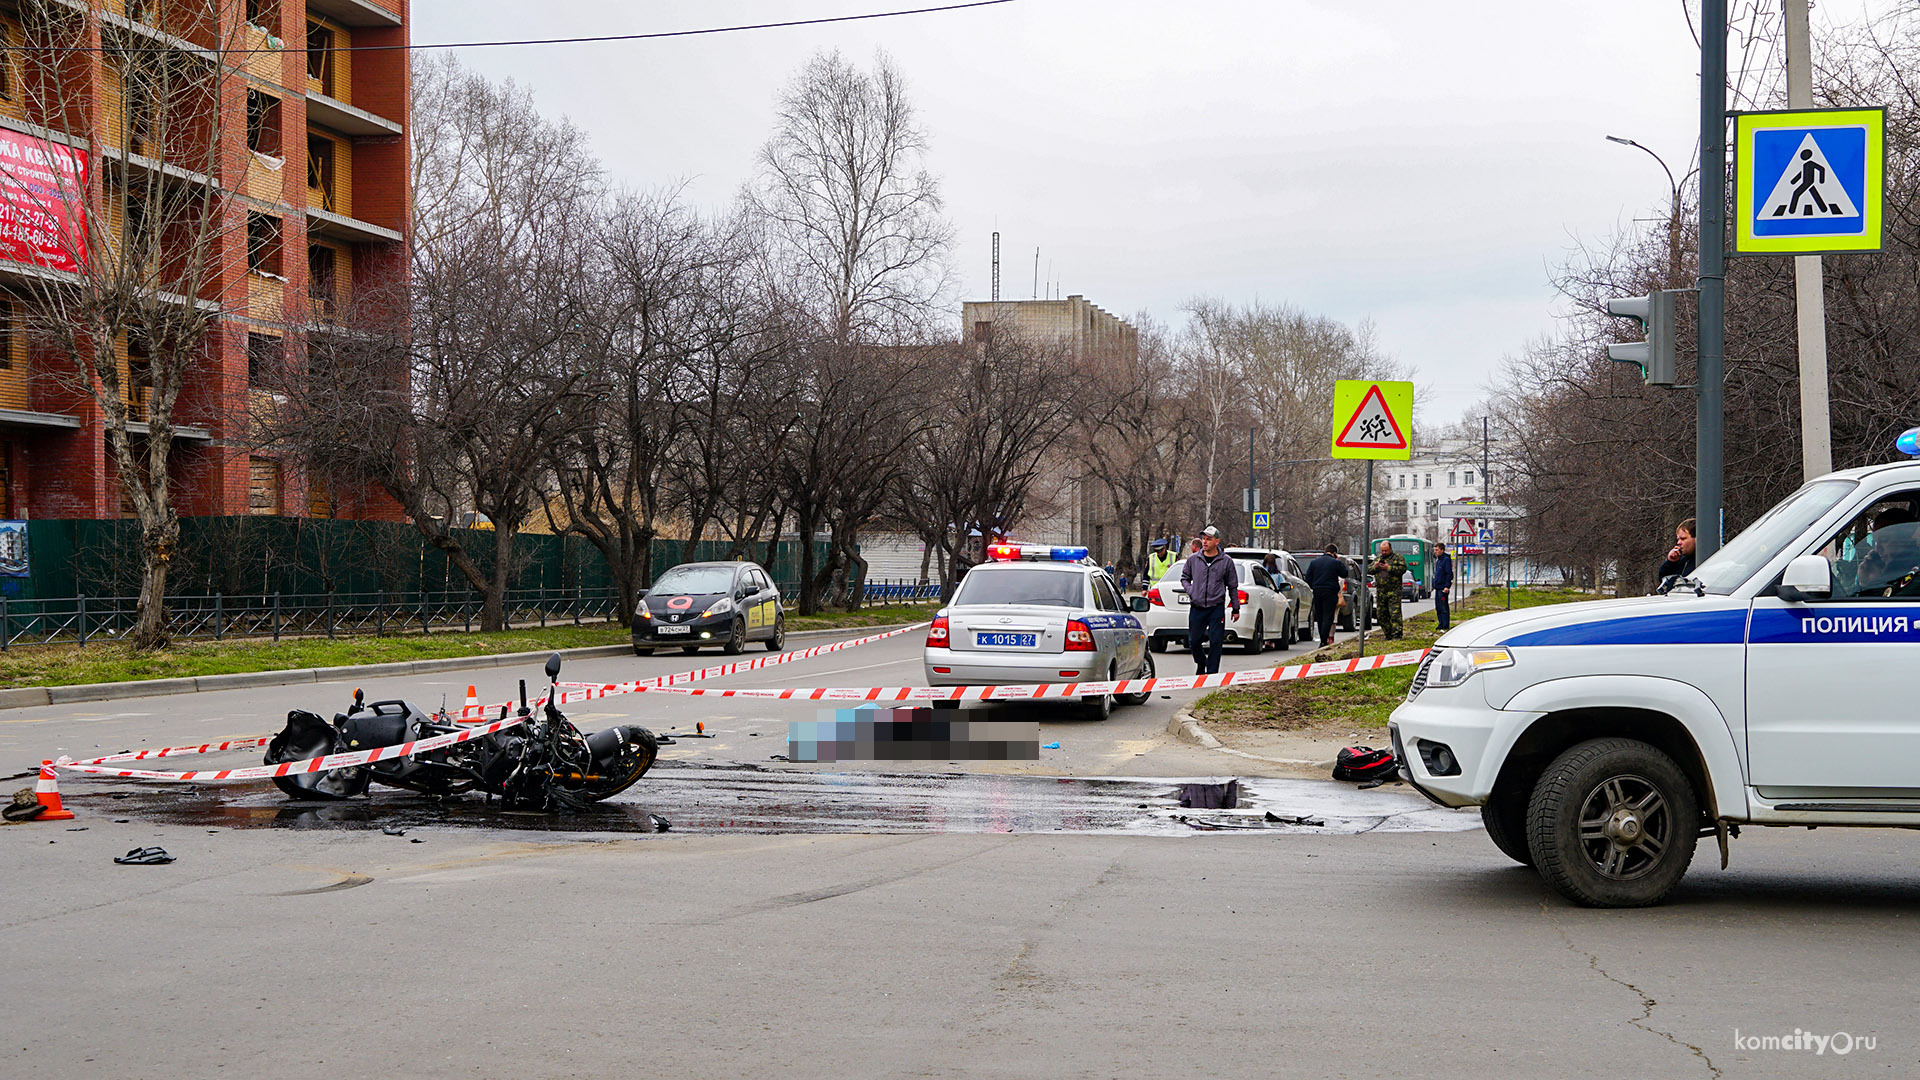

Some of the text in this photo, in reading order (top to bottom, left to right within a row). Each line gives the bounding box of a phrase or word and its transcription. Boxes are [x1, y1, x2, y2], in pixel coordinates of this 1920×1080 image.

[1802, 616, 1908, 635] ПОЛИЦИЯ
[992, 634, 1017, 645] 1015
[1022, 634, 1032, 643] 27
